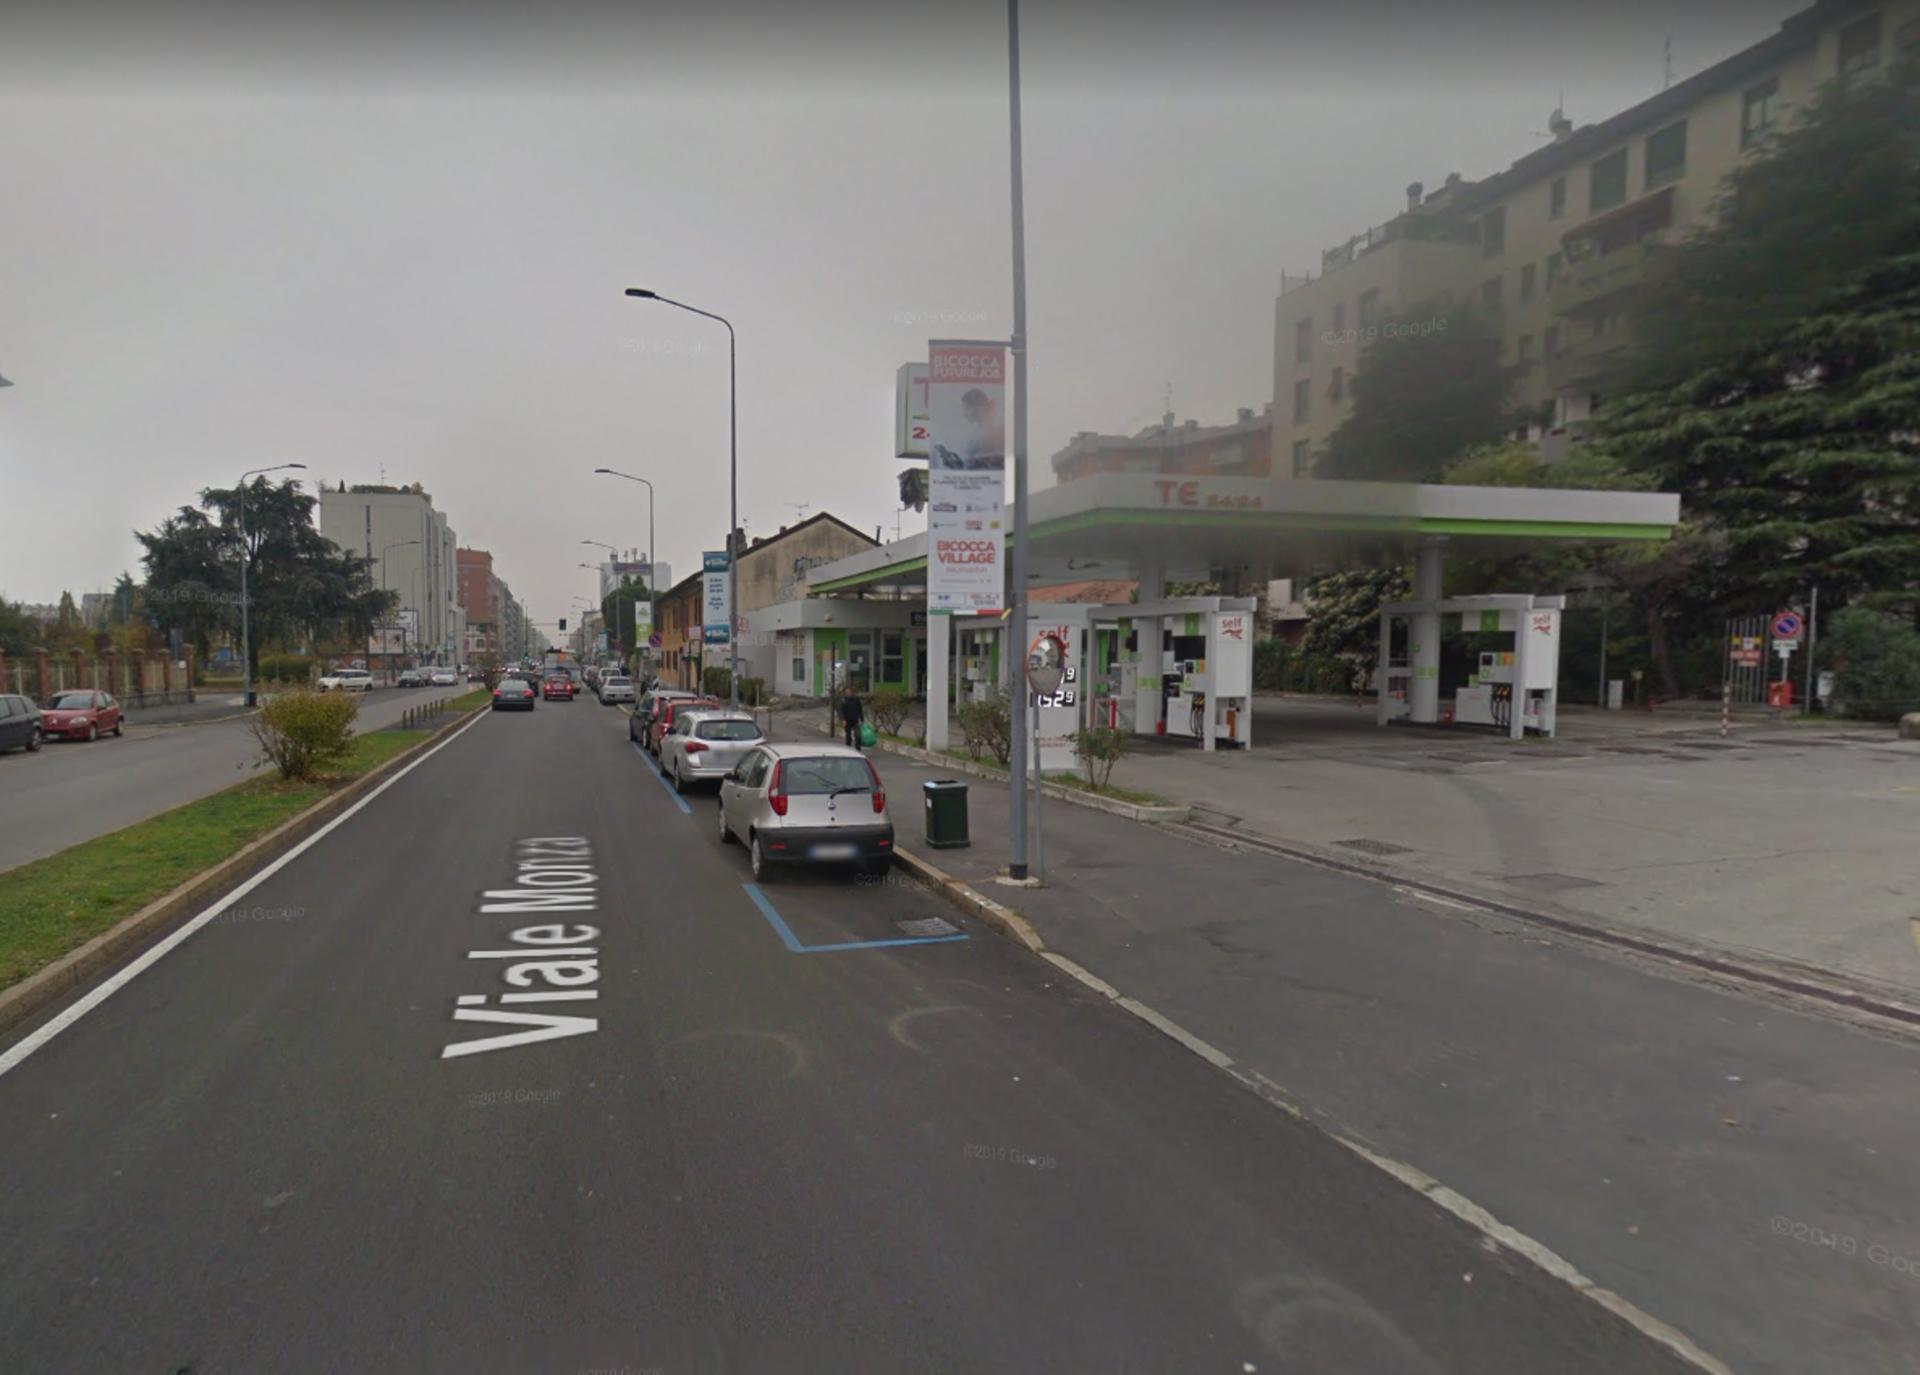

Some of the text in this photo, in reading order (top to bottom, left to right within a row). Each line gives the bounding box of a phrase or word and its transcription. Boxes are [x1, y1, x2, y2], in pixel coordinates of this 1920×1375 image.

[935, 354, 1000, 368] BICOCCA
[1153, 480, 1199, 506] TE
[936, 540, 996, 553] BICOCCA
[937, 552, 996, 564] VILLAGE
[1222, 616, 1242, 628] self
